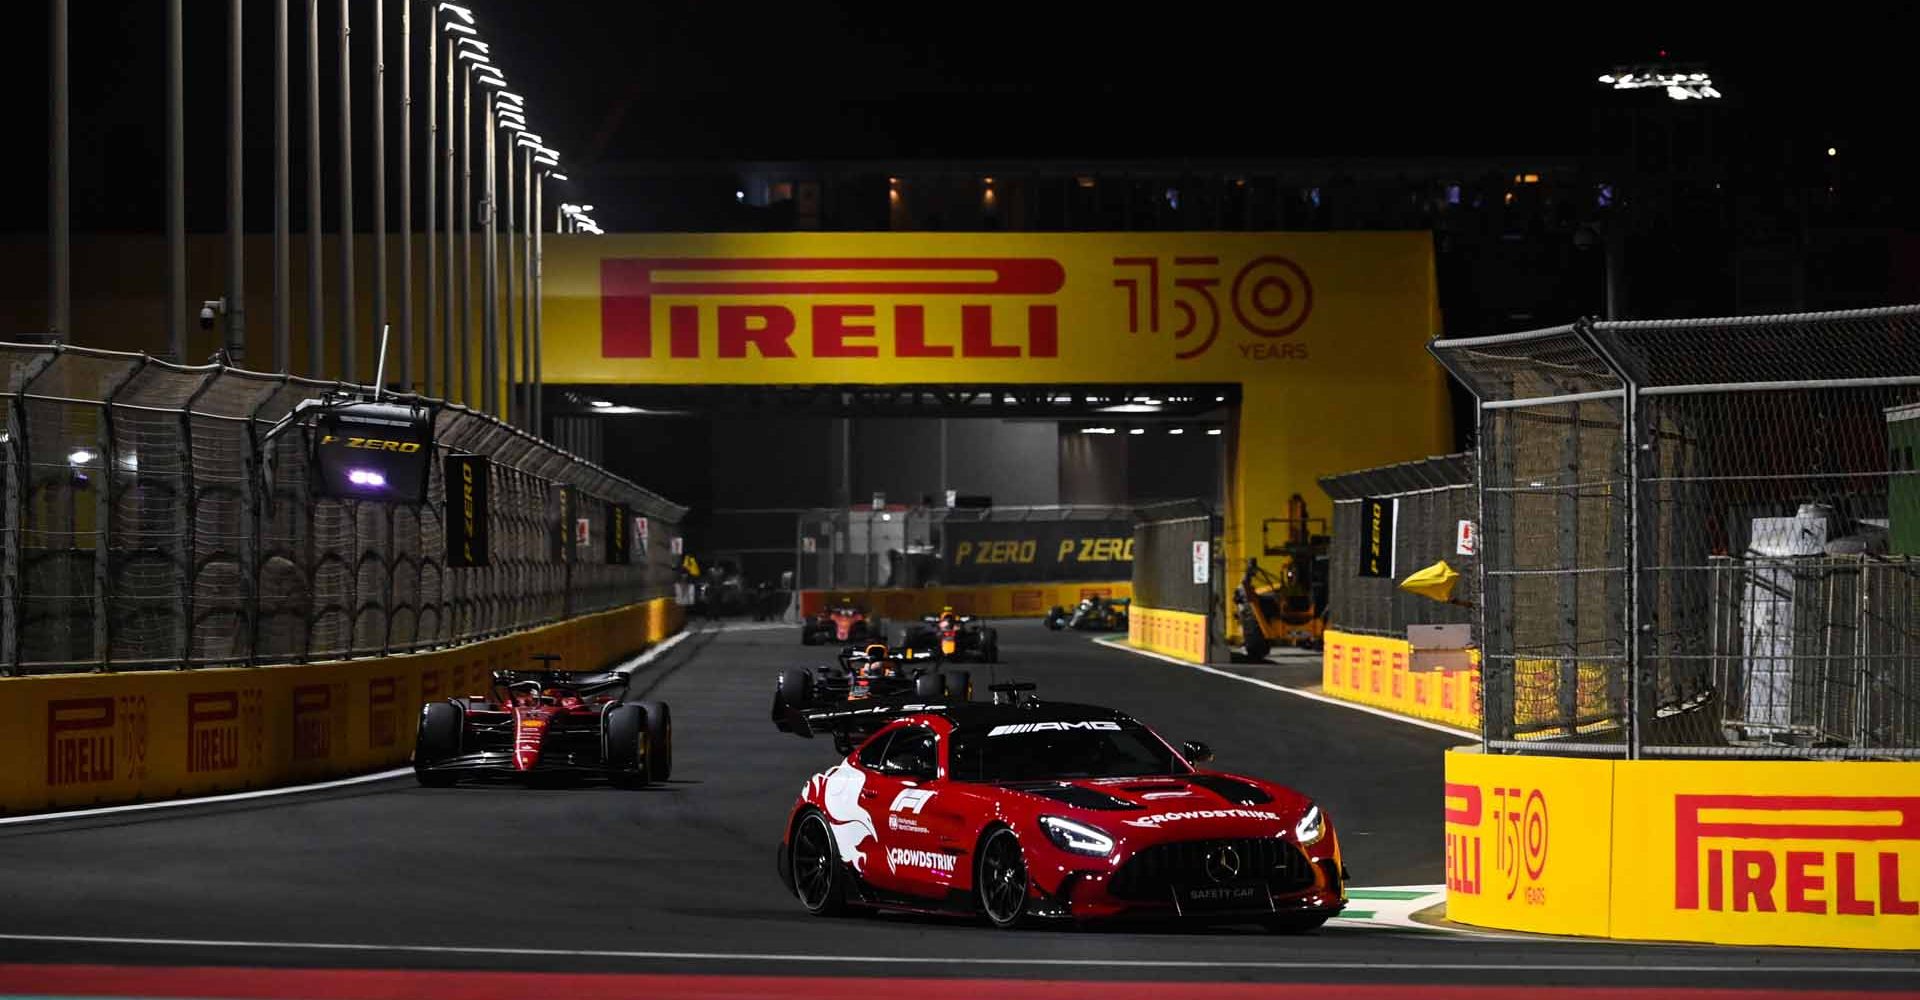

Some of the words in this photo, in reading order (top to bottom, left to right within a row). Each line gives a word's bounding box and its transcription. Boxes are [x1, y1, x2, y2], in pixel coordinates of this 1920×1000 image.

[600, 257, 1066, 358] PIRELLI
[1114, 256, 1312, 359] 150
[1239, 343, 1308, 359] YEARS
[344, 437, 422, 453] ZERO
[463, 460, 473, 538] ZERO
[1371, 501, 1382, 557] ZERO
[955, 541, 972, 565] P
[976, 540, 1037, 563] ZERO
[1057, 539, 1074, 562] P
[1032, 721, 1122, 732] AMG
[48, 697, 114, 786] PIRELLI
[1138, 809, 1281, 825] CROWDSTRIKE
[1493, 788, 1548, 900] 150
[1189, 888, 1232, 900] SAFETY
[1233, 887, 1256, 898] CAR
